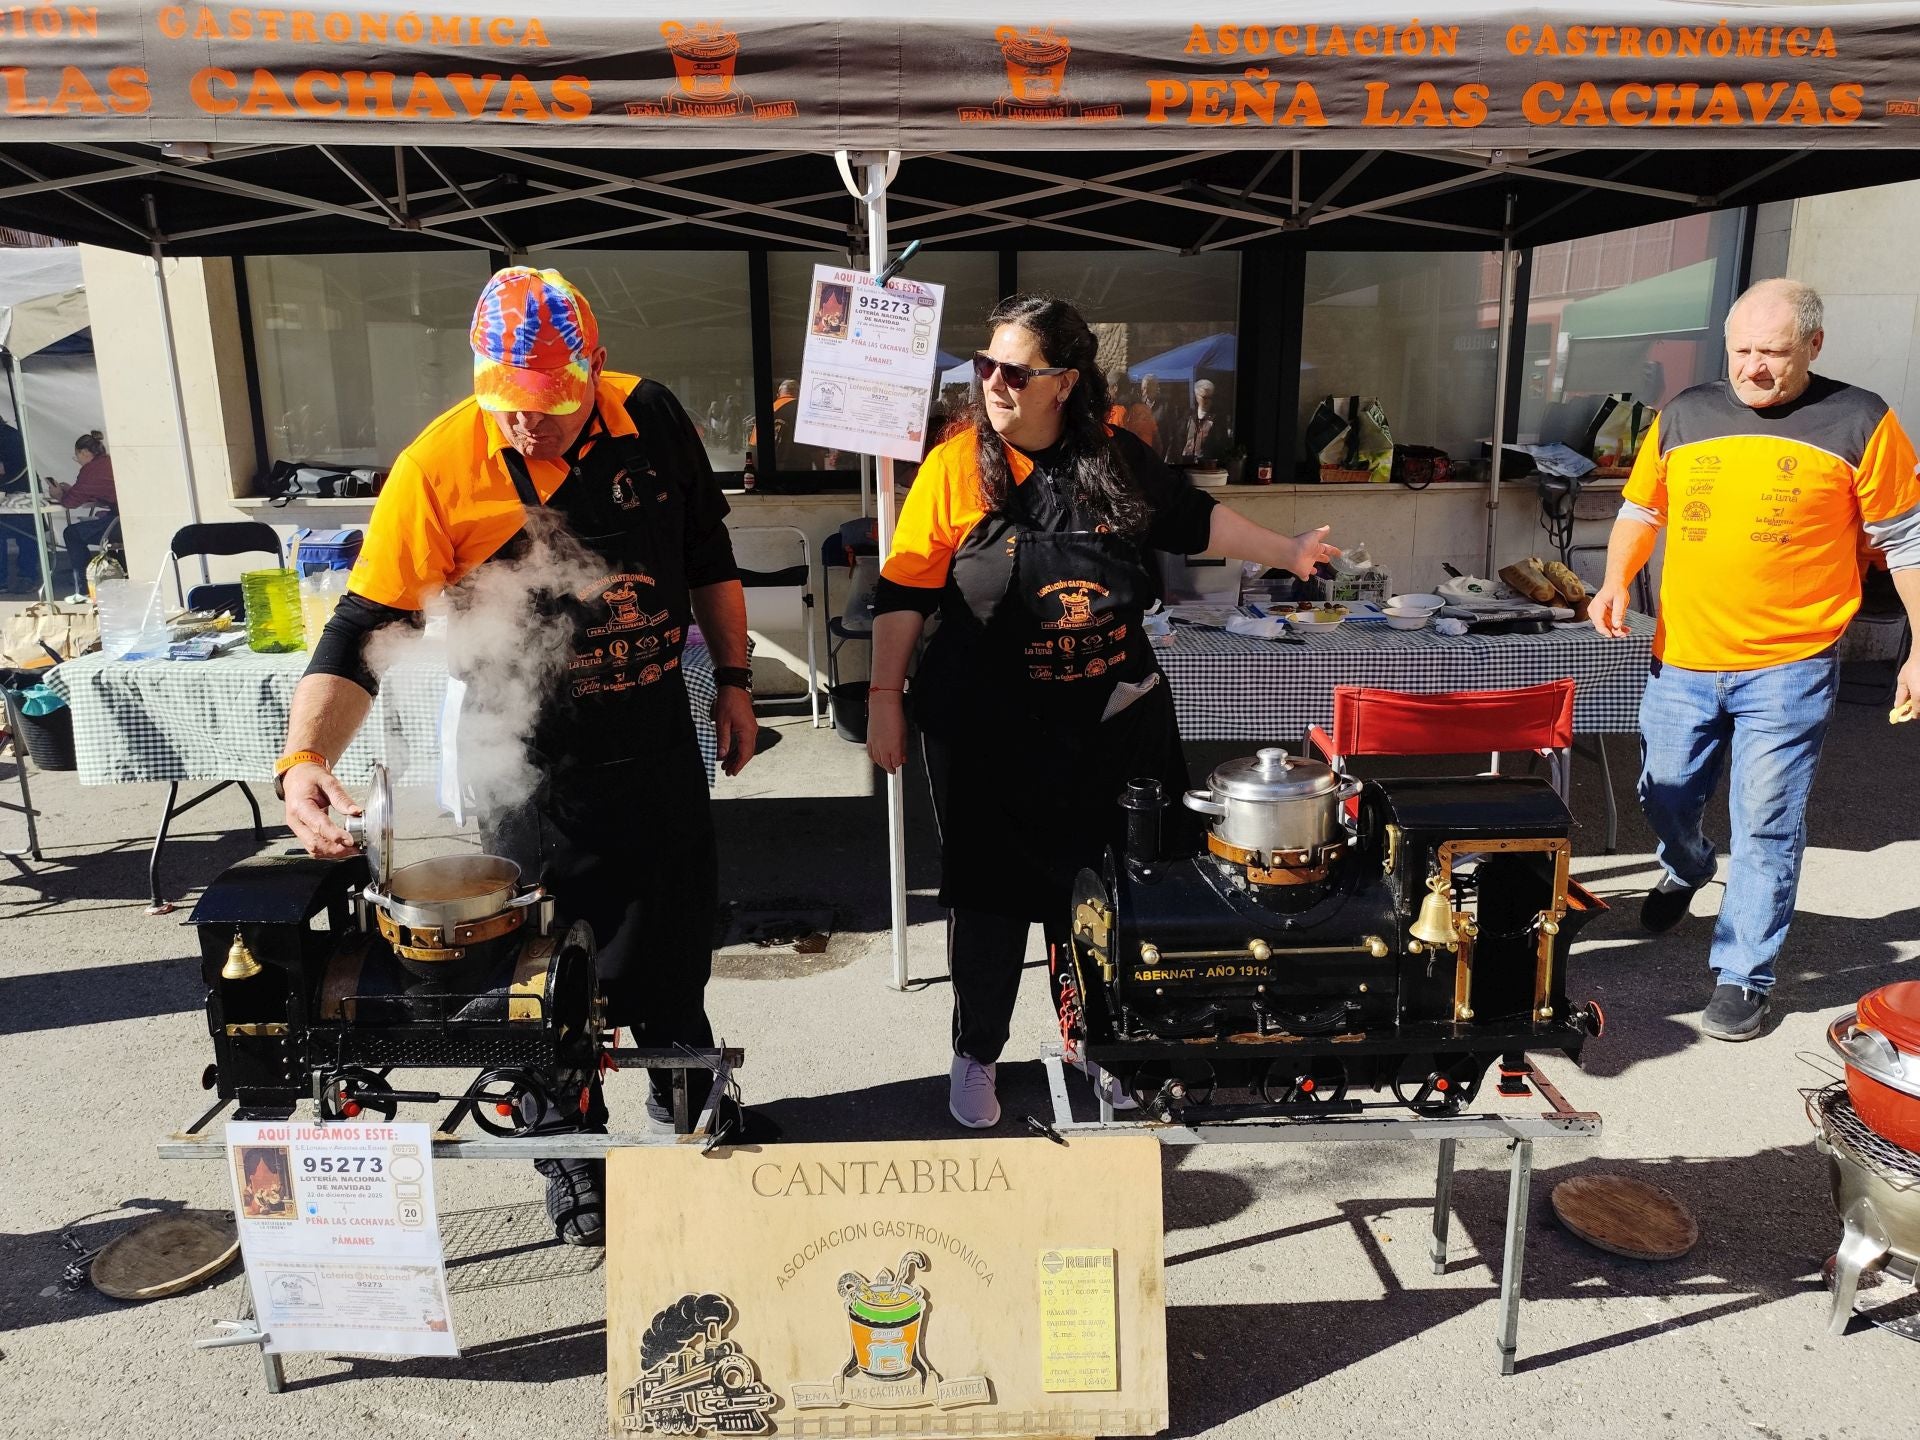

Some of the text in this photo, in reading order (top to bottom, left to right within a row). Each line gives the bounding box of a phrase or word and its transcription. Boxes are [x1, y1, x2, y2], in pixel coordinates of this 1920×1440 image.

[0, 0, 550, 48] IÓN GASTRONÓMICA
[1184, 18, 1838, 59] ASOCIACIÓN GASTRONÓMICA
[0, 65, 592, 121] LAS CACHAVAS
[1144, 66, 1865, 128] PEÑA LAS CACHAVAS
[630, 103, 660, 115] PEÑA
[677, 102, 694, 116] LAS
[694, 103, 736, 117] CACHAVAS
[961, 108, 992, 121] PEÑA
[1008, 107, 1023, 120] LAS
[1024, 107, 1064, 121] CACHAVAS
[1889, 102, 1916, 114] PEÑA
[834, 271, 856, 283] AQUÍ
[858, 275, 900, 290] JUGOS
[902, 285, 924, 295] ESTE:
[859, 296, 910, 315] 95273
[855, 308, 911, 322] LOTERÍA NACIONAL
[873, 318, 900, 326] NAVIDAD
[851, 338, 867, 346] PEÑA
[879, 343, 910, 354] CACHAVAS
[916, 341, 925, 349] 20
[1134, 968, 1195, 981] ABERNAT
[1205, 965, 1236, 978] AÑO
[1239, 965, 1268, 976] 1914
[257, 1126, 399, 1141] AQUÍ JUGAMOS ESTE:
[303, 1157, 383, 1173] 95273
[300, 1175, 387, 1183] LOTERÍA NACIONAL
[751, 1156, 1016, 1197] CANTABRIA
[404, 1208, 417, 1218] 20
[306, 1215, 396, 1227] PEÑA LAS CACHAVAS
[332, 1234, 376, 1246] PÁMANES
[776, 1220, 995, 1291] ASOCIACION GASTRONOMICA
[1065, 1255, 1112, 1269] RENFE
[365, 1271, 410, 1281] Nacional
